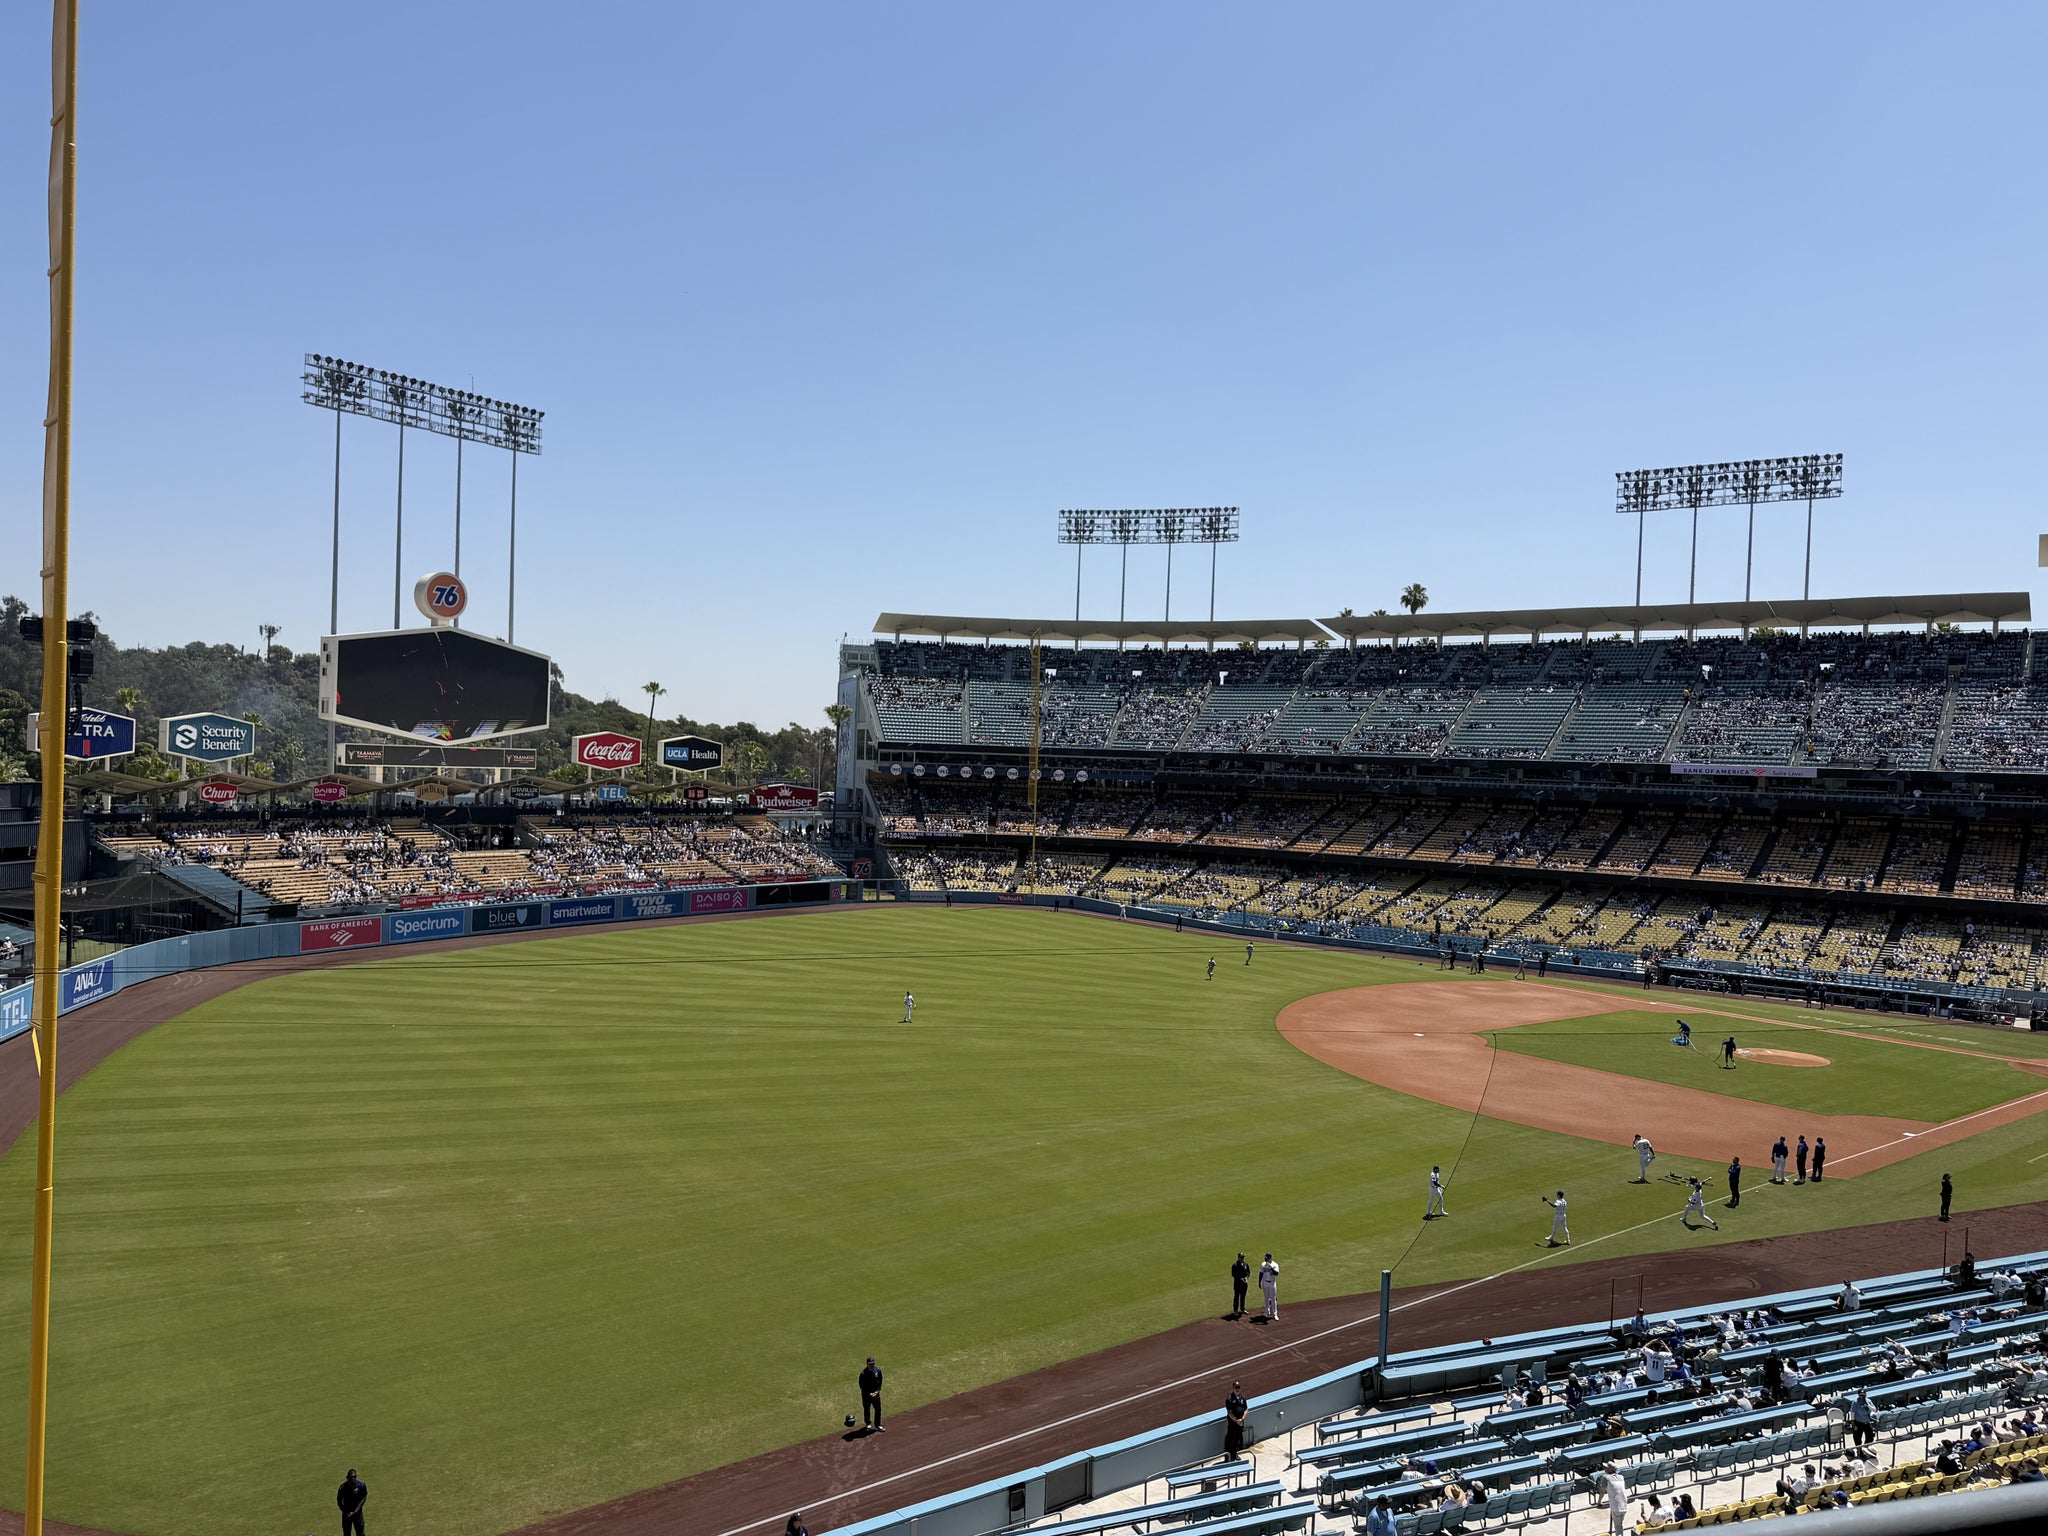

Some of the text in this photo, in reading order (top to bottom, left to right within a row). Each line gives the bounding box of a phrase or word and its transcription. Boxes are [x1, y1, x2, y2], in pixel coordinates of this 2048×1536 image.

[433, 585, 459, 607] 76
[73, 725, 115, 737] LTRA
[202, 725, 247, 741] Security
[202, 740, 242, 751] Benefit
[583, 741, 636, 761] Coca-Cola
[667, 750, 719, 760] UCLA Health
[201, 786, 236, 800] Churu
[602, 788, 623, 799] TEL
[756, 795, 812, 807] Budweiser
[855, 861, 871, 875] 76
[632, 895, 665, 907] TOYO
[696, 892, 730, 903] DAISO
[553, 904, 612, 919] smartwater
[637, 904, 672, 916] TIRES
[489, 911, 515, 924] blue
[310, 923, 330, 931] BANK
[341, 919, 373, 928] AMERICA
[395, 916, 455, 936] Spectrum
[73, 970, 94, 994] ANA
[3, 996, 28, 1030] TEL
[1652, 1360, 1659, 1369] 11
[1955, 1458, 1963, 1470] 5
